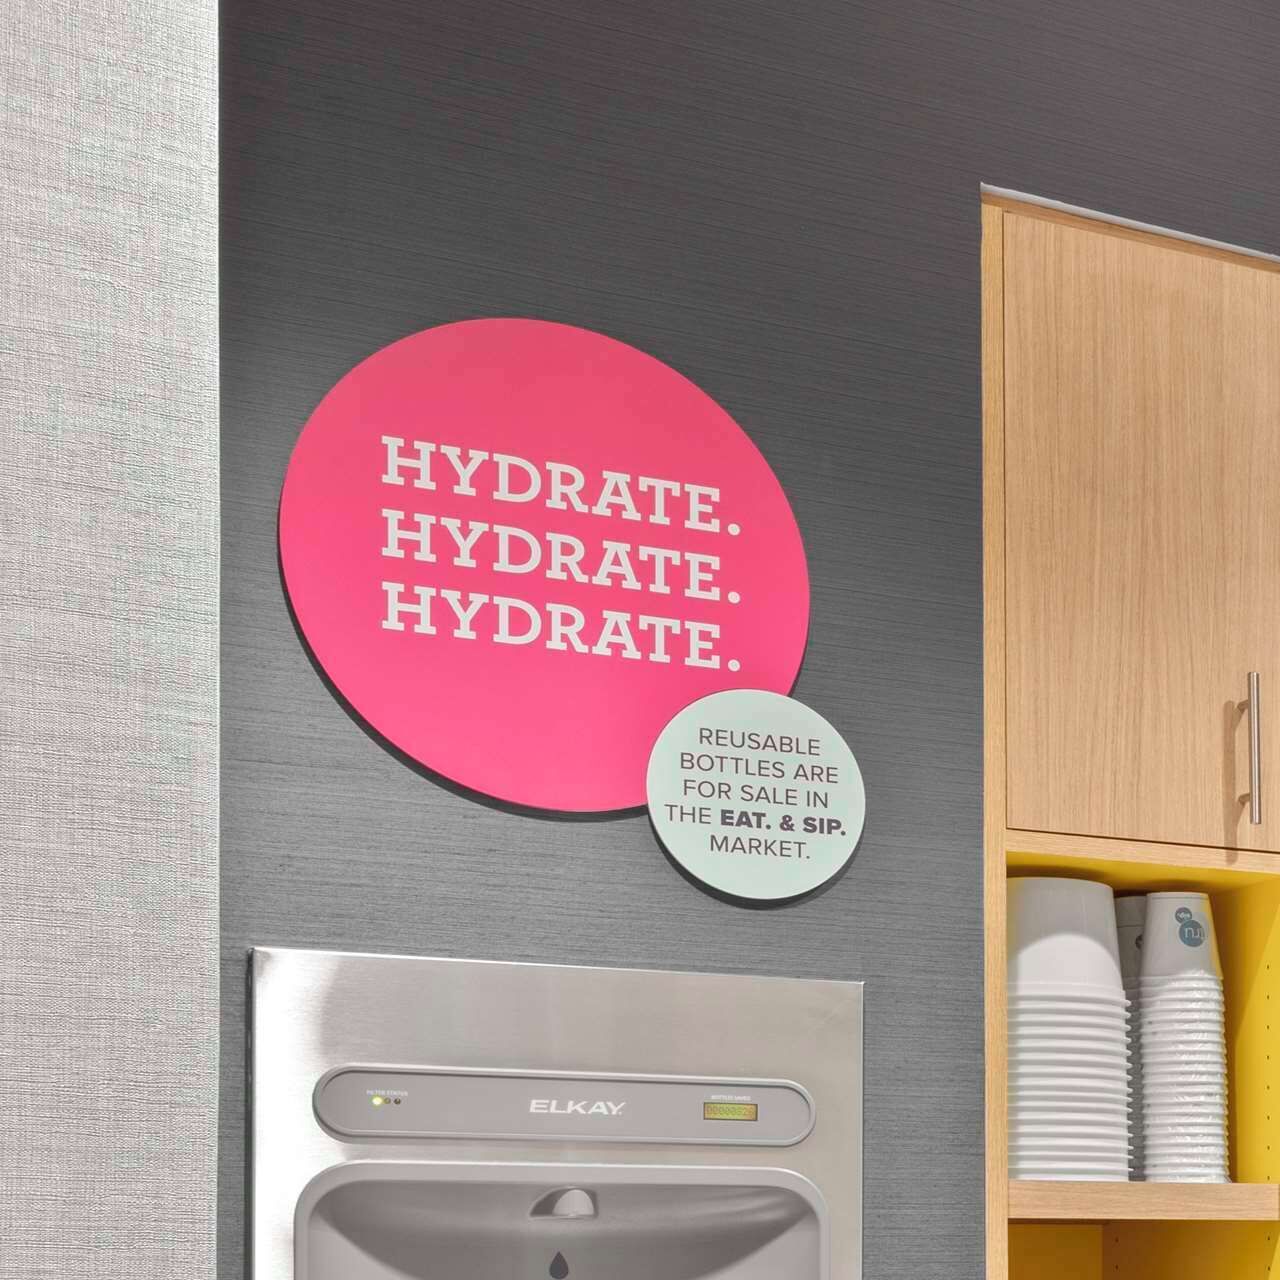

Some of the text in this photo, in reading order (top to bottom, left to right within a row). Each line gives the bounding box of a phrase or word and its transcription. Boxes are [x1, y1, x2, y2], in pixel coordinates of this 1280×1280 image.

[381, 435, 741, 536] HYDRATE.
[381, 508, 741, 604] HYDRATE.
[381, 581, 741, 672] HYDRATE.
[698, 727, 821, 756] REUSABLE
[680, 752, 839, 784] BOTTLES ARE
[683, 779, 829, 809] FOR SALE IN
[664, 803, 847, 836] THE EAT. & SIP.
[710, 834, 811, 859] MARKET.
[529, 1099, 627, 1115] ELKAY
